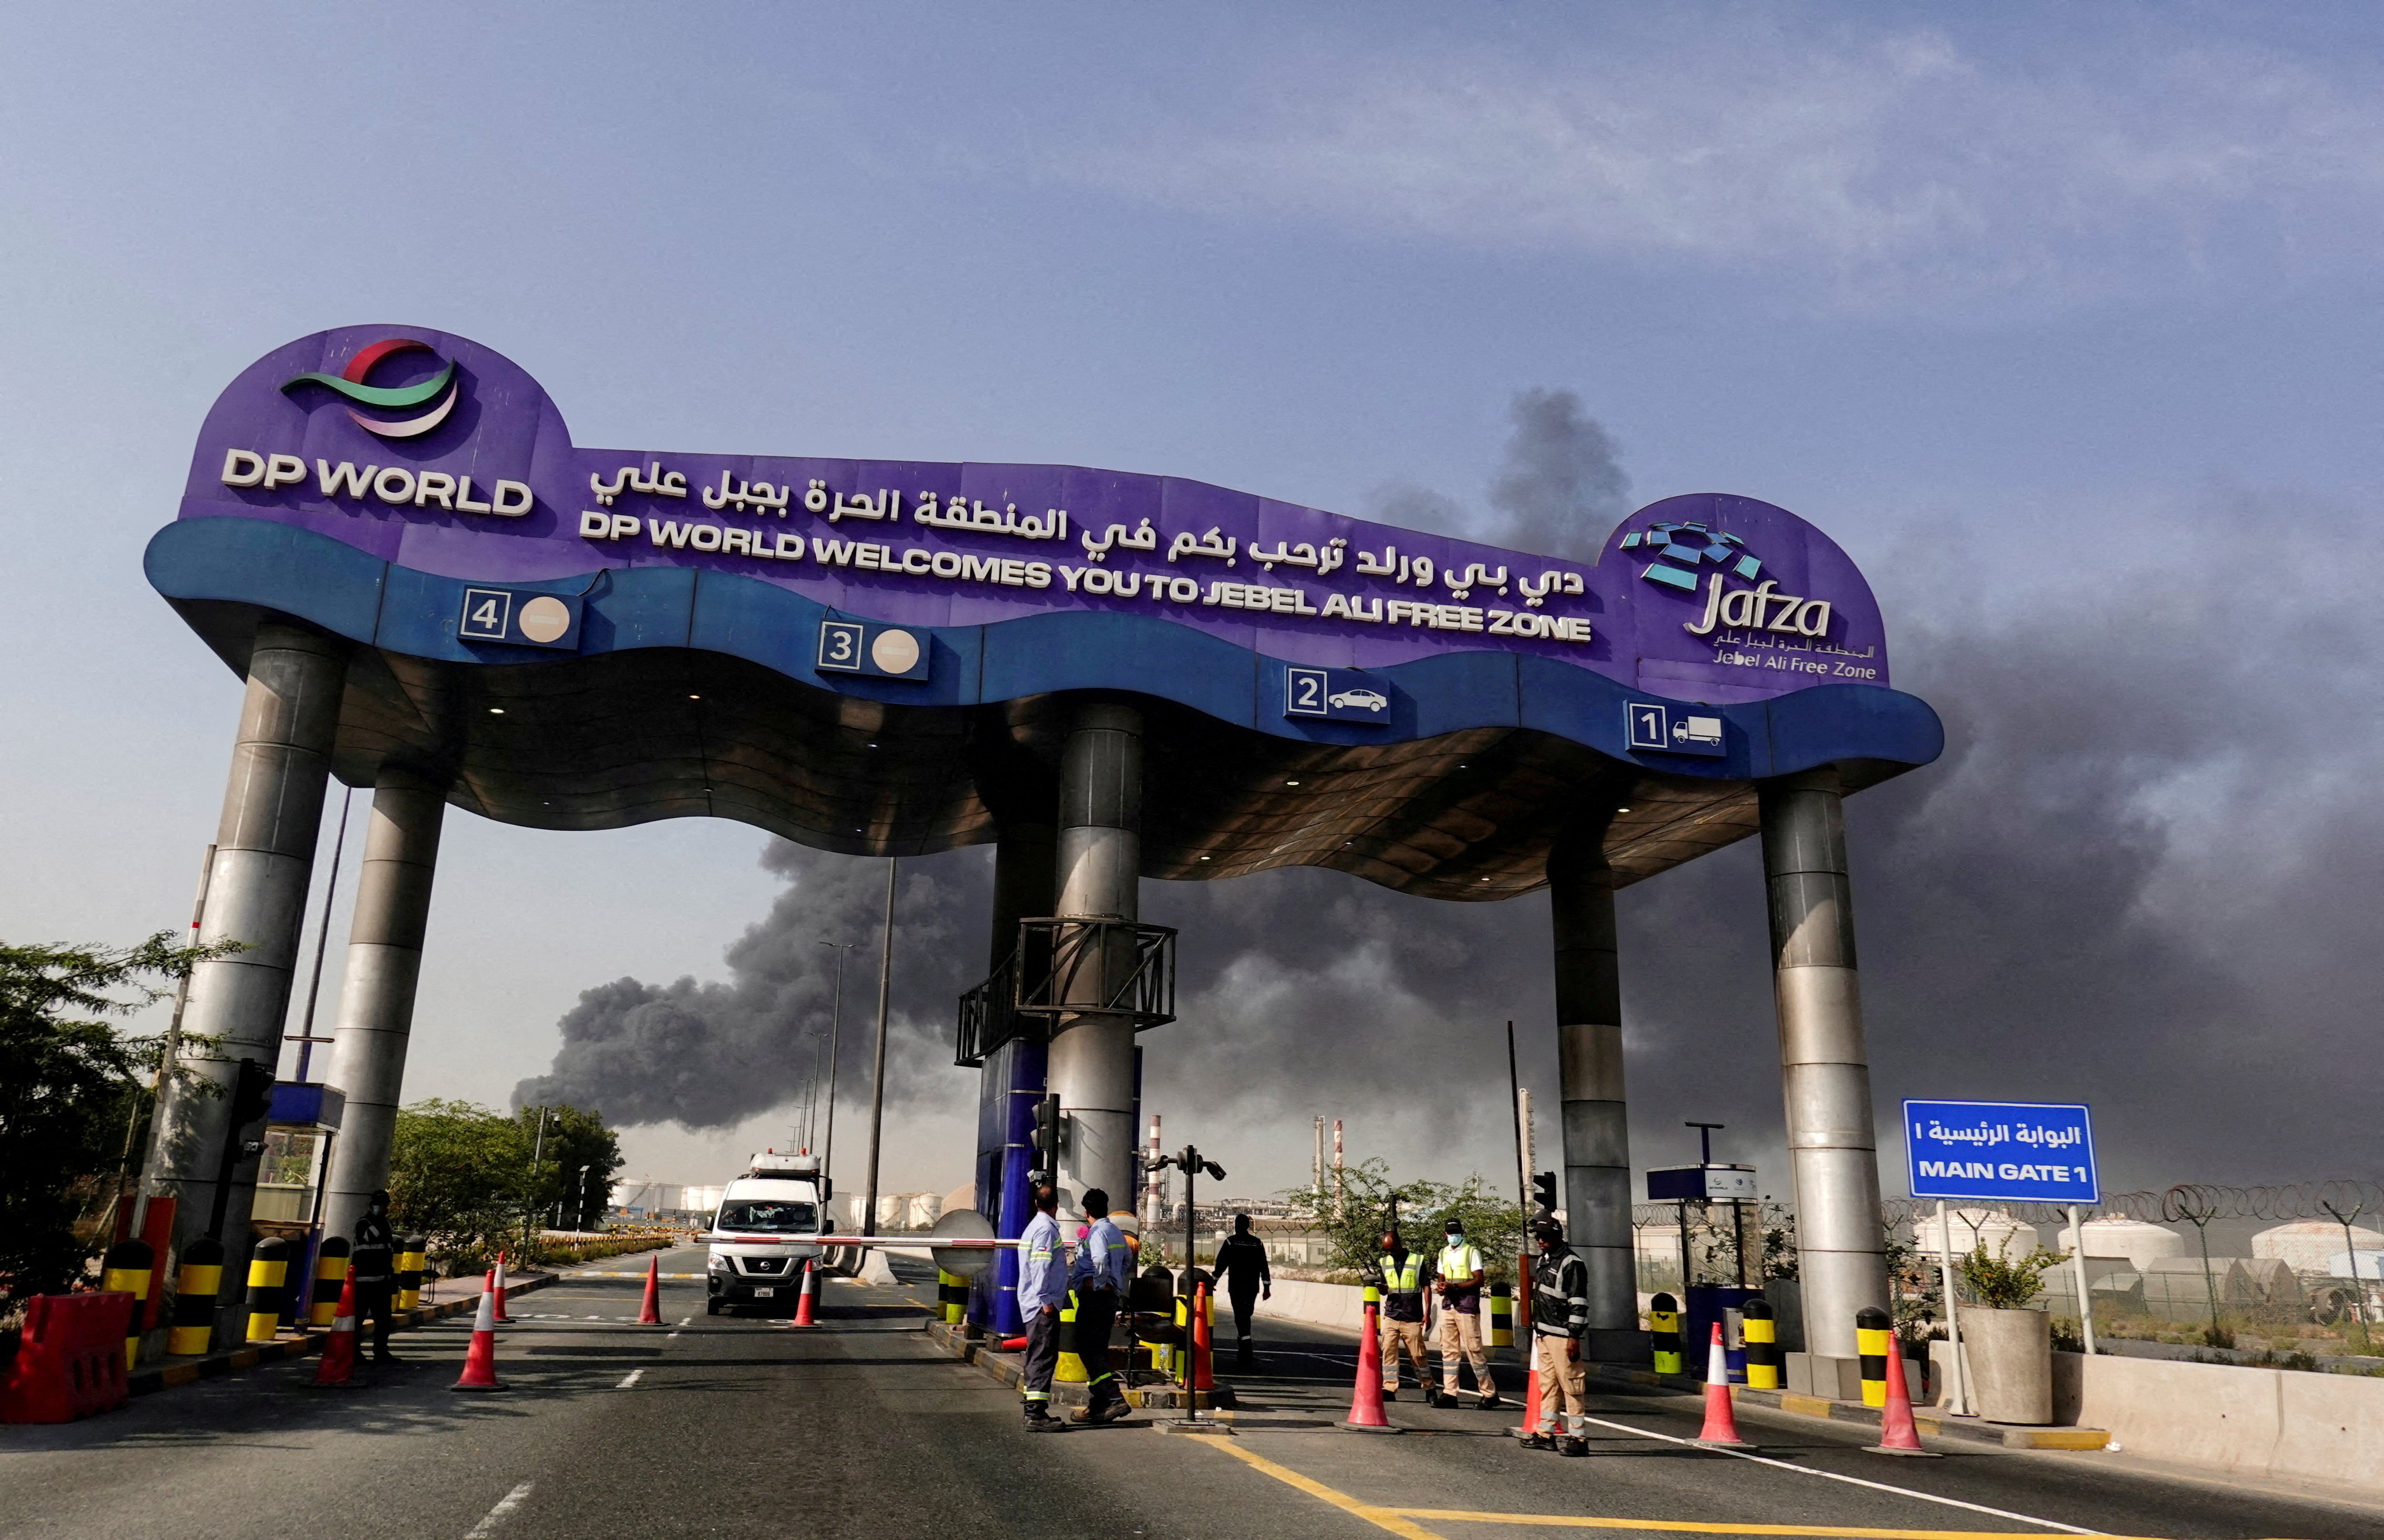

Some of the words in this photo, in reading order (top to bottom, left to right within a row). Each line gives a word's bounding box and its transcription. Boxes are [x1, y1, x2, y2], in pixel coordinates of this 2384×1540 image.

[221, 448, 307, 490] DP
[317, 459, 533, 516] WORLD
[591, 462, 687, 505] علي
[703, 470, 790, 518] بجبل
[805, 479, 900, 523] الحرة
[915, 490, 1067, 540] المنطقة
[1081, 517, 1156, 563] في
[1168, 526, 1236, 565] بكم
[1249, 537, 1347, 575] ترحب
[579, 511, 640, 541] DP
[648, 519, 805, 561] WORLD
[812, 538, 1051, 589] WELCOMES
[1064, 565, 1140, 598] YOU
[1145, 575, 1198, 603] TO
[1202, 582, 1317, 616] JEBEL
[1322, 594, 1382, 623] ALI
[1387, 600, 1483, 633] FREE
[1488, 609, 1591, 643] ZONE
[1356, 546, 1433, 586] ورلد
[1444, 561, 1508, 599] بي
[1519, 568, 1584, 606] دي
[1683, 573, 1830, 637] Jafza
[473, 599, 498, 629] 4
[830, 631, 852, 661] 3
[1714, 630, 1740, 647] علي
[1778, 639, 1811, 652] الحرة
[1815, 643, 1874, 658] المنطقة
[1713, 649, 1760, 667] Jebel
[1764, 656, 1787, 669] Ali
[1791, 657, 1828, 674] Free
[1832, 661, 1876, 679] Zone
[1298, 677, 1318, 707] 2
[1641, 712, 1656, 739] 1
[1929, 1120, 2010, 1146] الرئيسية
[2015, 1123, 2081, 1149] البوابة
[1919, 1161, 1994, 1179] MAIN
[1998, 1164, 2070, 1182] GATE
[2074, 1167, 2087, 1182] 1
